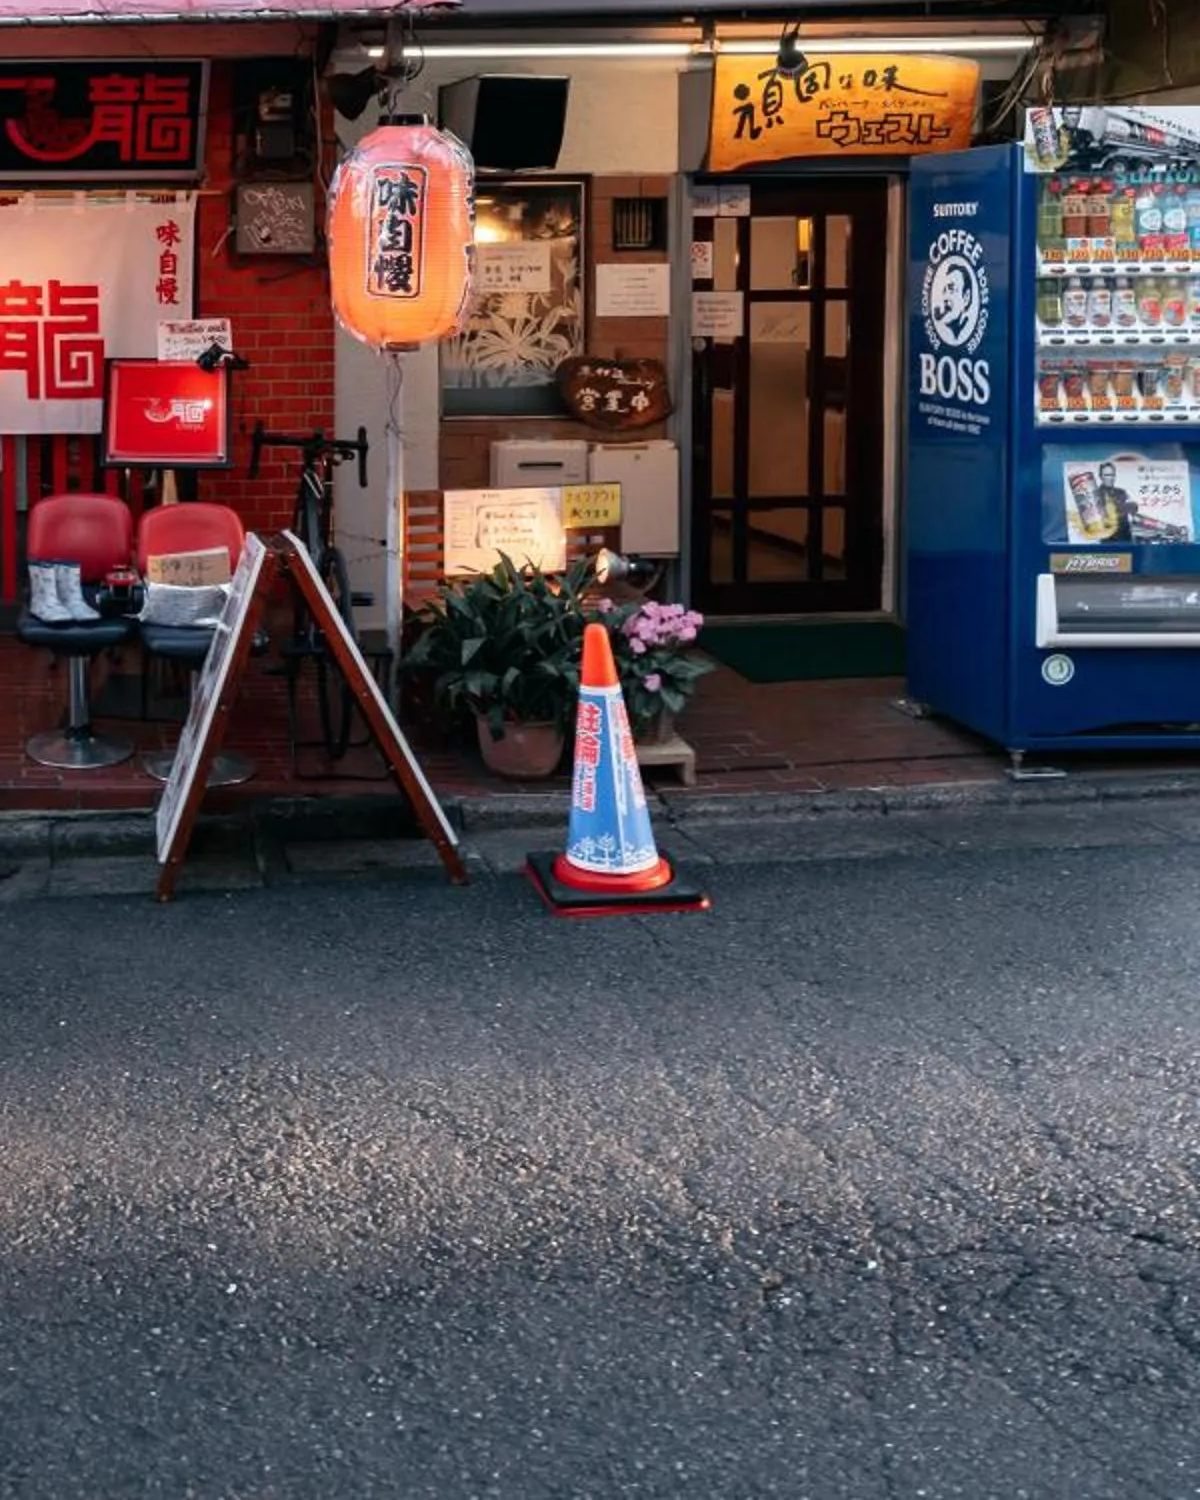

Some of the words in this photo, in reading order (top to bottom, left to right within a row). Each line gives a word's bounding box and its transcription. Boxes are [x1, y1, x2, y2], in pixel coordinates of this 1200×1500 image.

[933, 202, 979, 217] SUNTORY
[155, 219, 182, 305] 味自慢
[929, 229, 983, 266] COFFEE
[919, 353, 990, 405] BOSS
